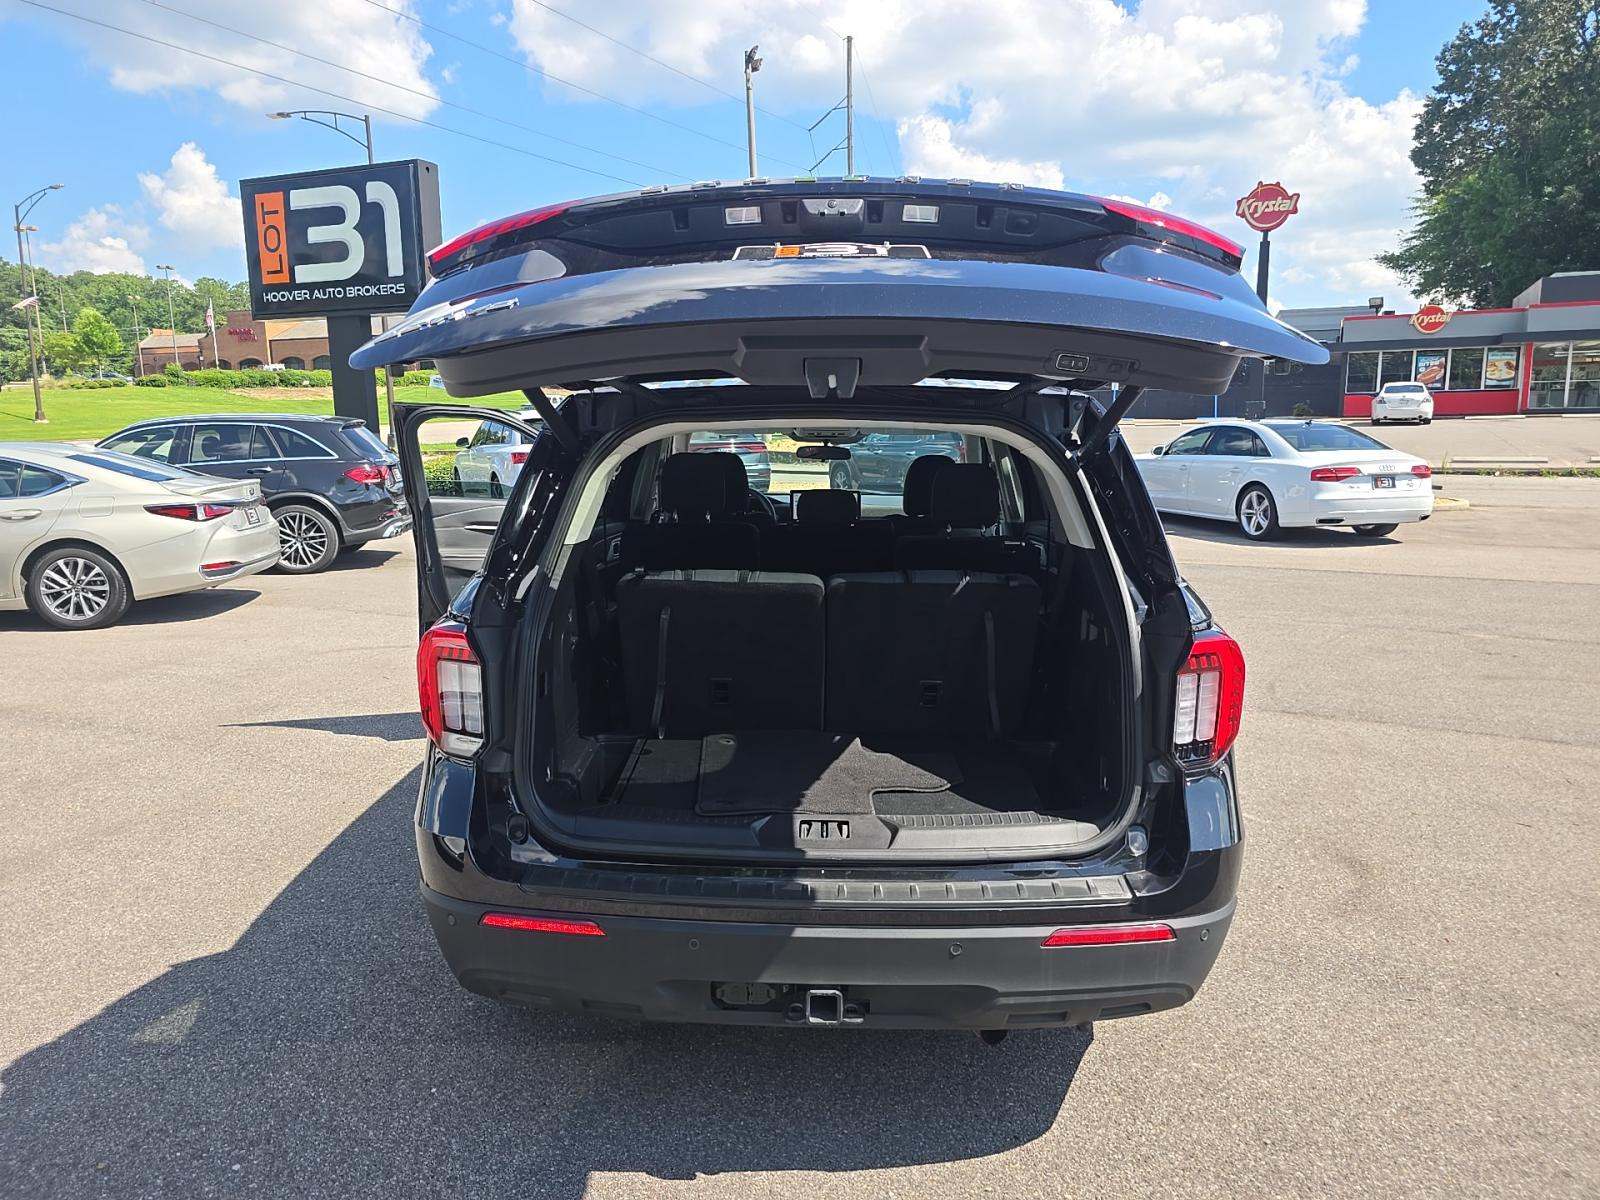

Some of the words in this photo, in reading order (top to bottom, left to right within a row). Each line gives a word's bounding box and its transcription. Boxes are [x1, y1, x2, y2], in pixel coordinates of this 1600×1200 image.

[1238, 195, 1297, 218] Krystal
[261, 202, 283, 275] LOT
[290, 180, 404, 284] 31
[262, 289, 310, 303] HOOVER
[312, 287, 344, 300] AUTO
[346, 283, 406, 298] BROKERS
[1409, 312, 1453, 326] Krystal
